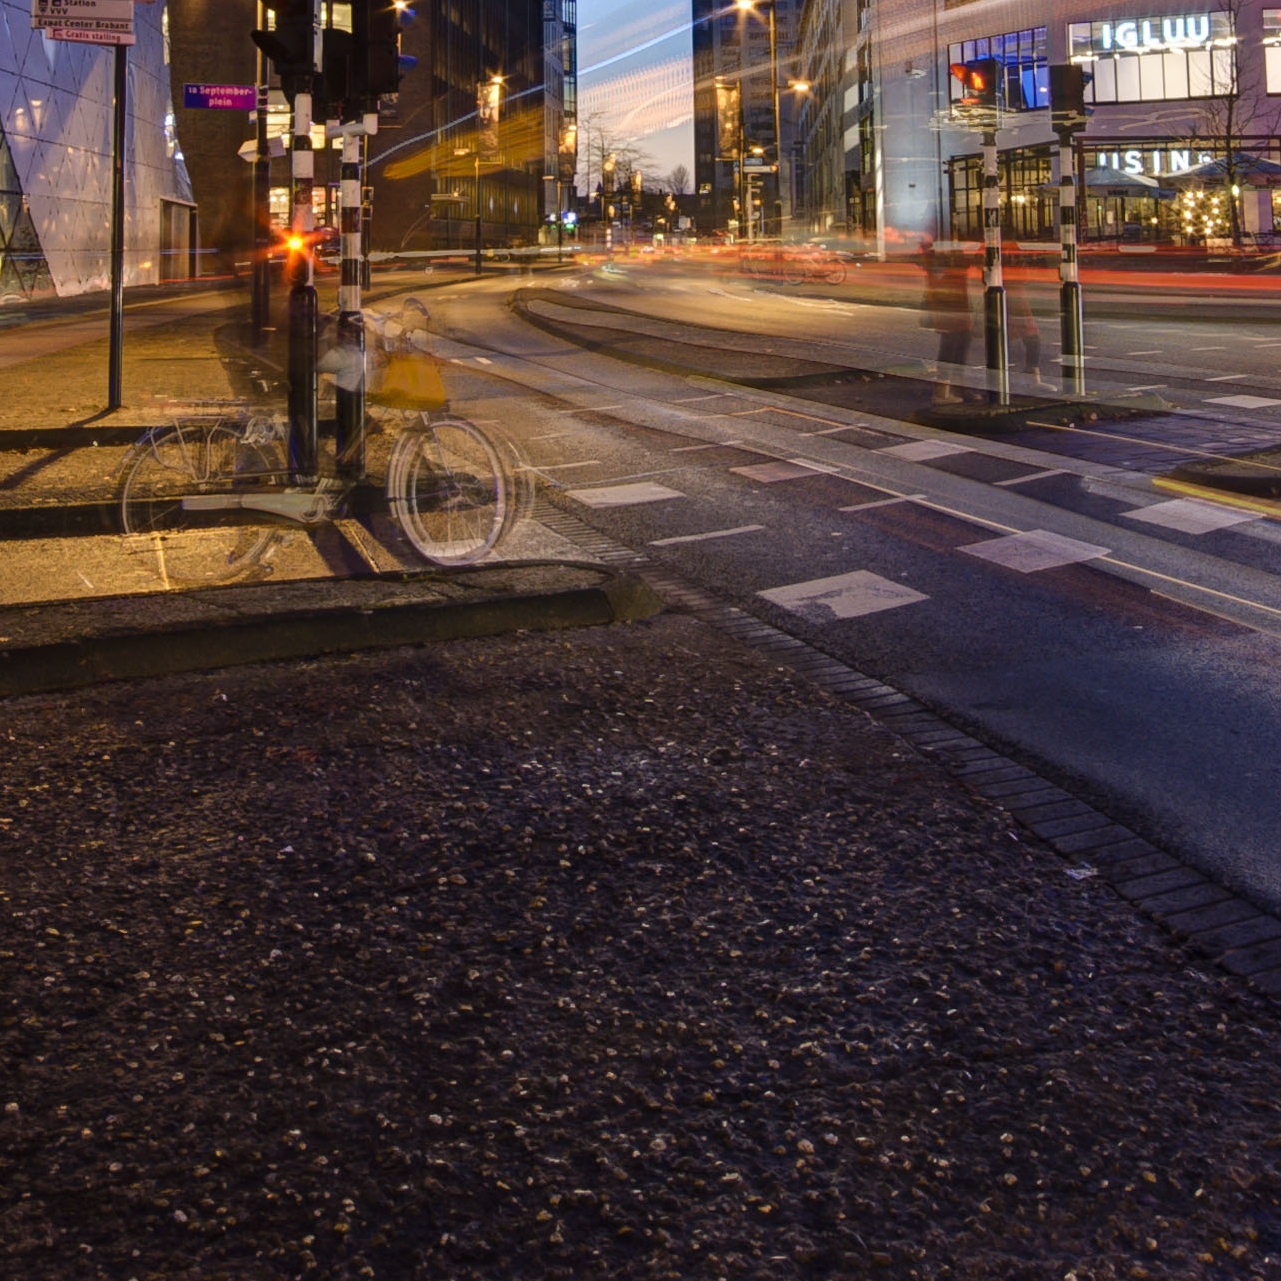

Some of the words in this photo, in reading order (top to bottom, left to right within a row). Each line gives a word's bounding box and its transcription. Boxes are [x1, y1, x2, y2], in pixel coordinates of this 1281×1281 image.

[50, 7, 69, 15] VVV
[64, 19, 94, 28] Center
[95, 21, 129, 30] Brabant
[65, 30, 89, 39] Gratis
[91, 31, 121, 42] stalling
[1102, 16, 1210, 50] IGLUU
[199, 86, 253, 96] September-
[208, 97, 233, 107] plein
